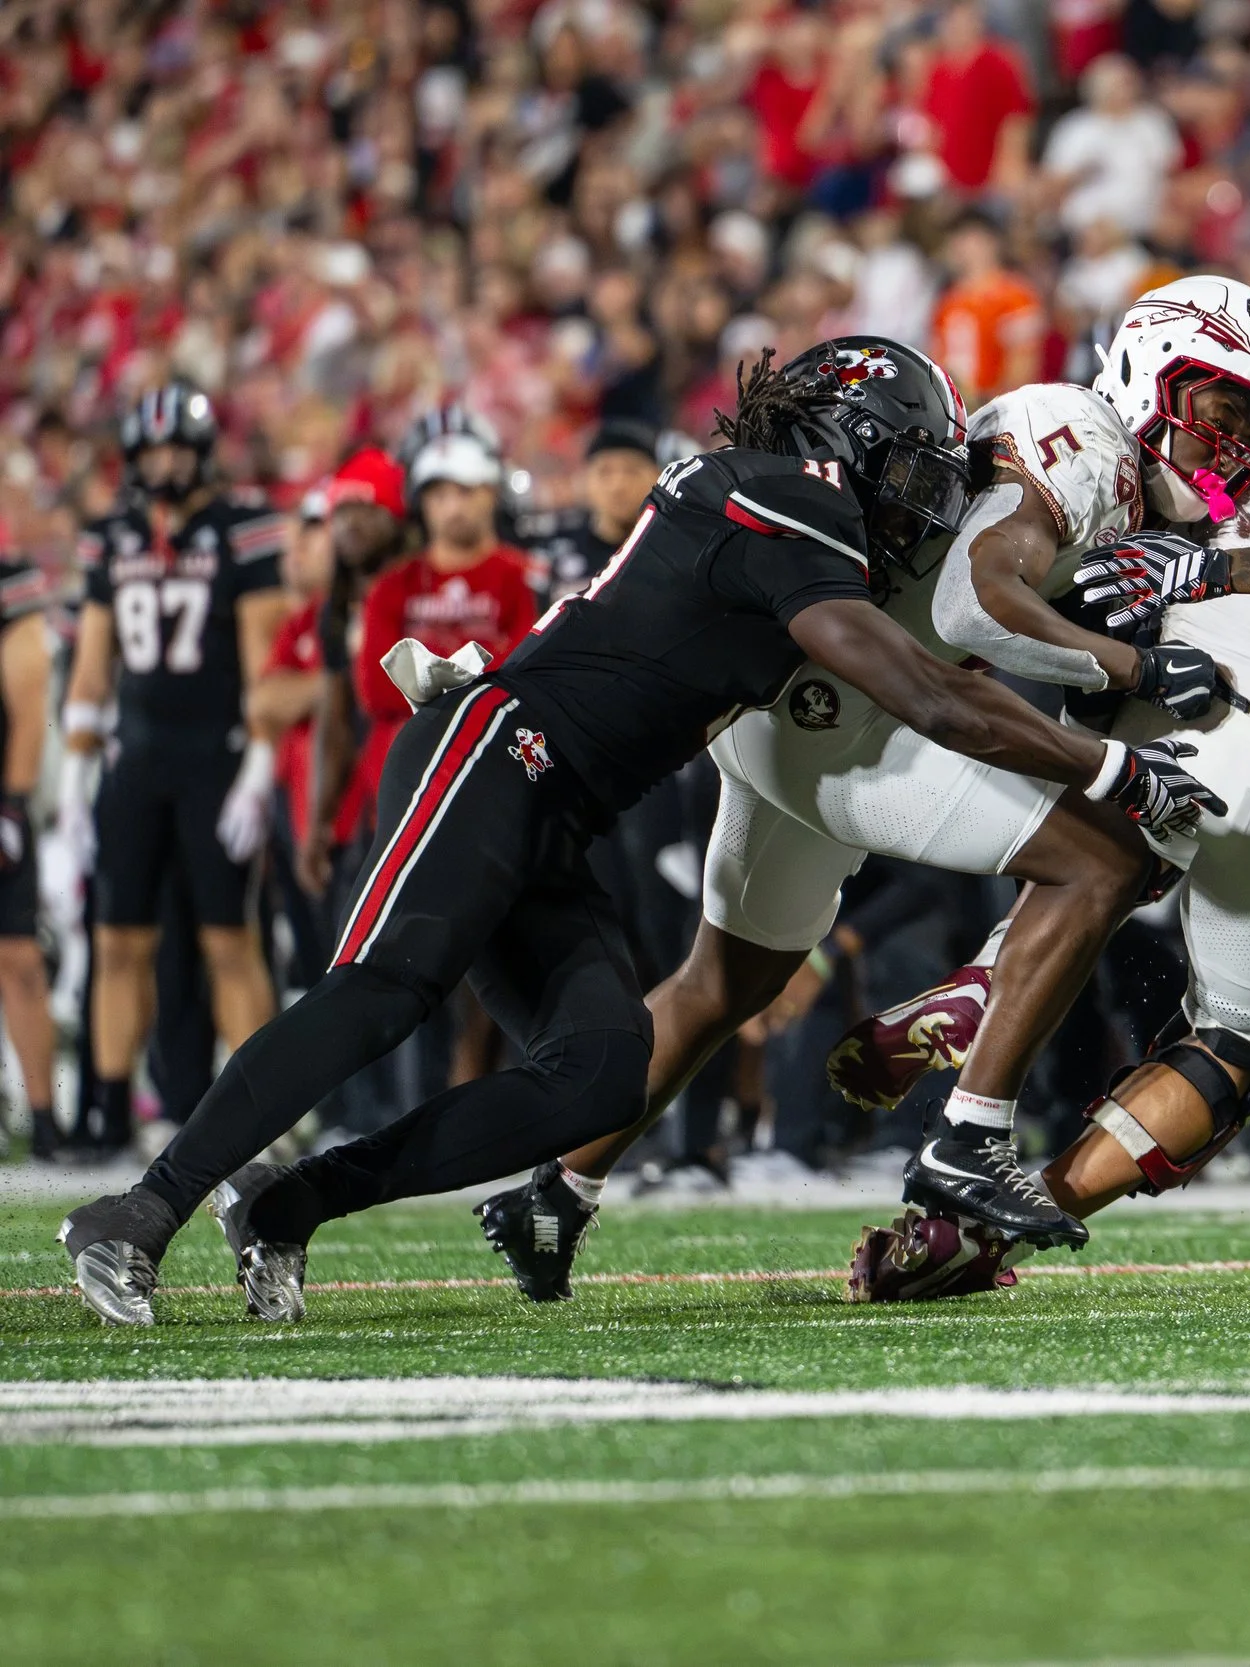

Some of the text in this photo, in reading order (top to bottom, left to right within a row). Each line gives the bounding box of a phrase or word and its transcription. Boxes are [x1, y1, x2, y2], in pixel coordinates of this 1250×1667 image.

[113, 579, 212, 674] 87
[951, 1090, 1000, 1109] Supreme
[532, 1214, 559, 1254] NIKE
